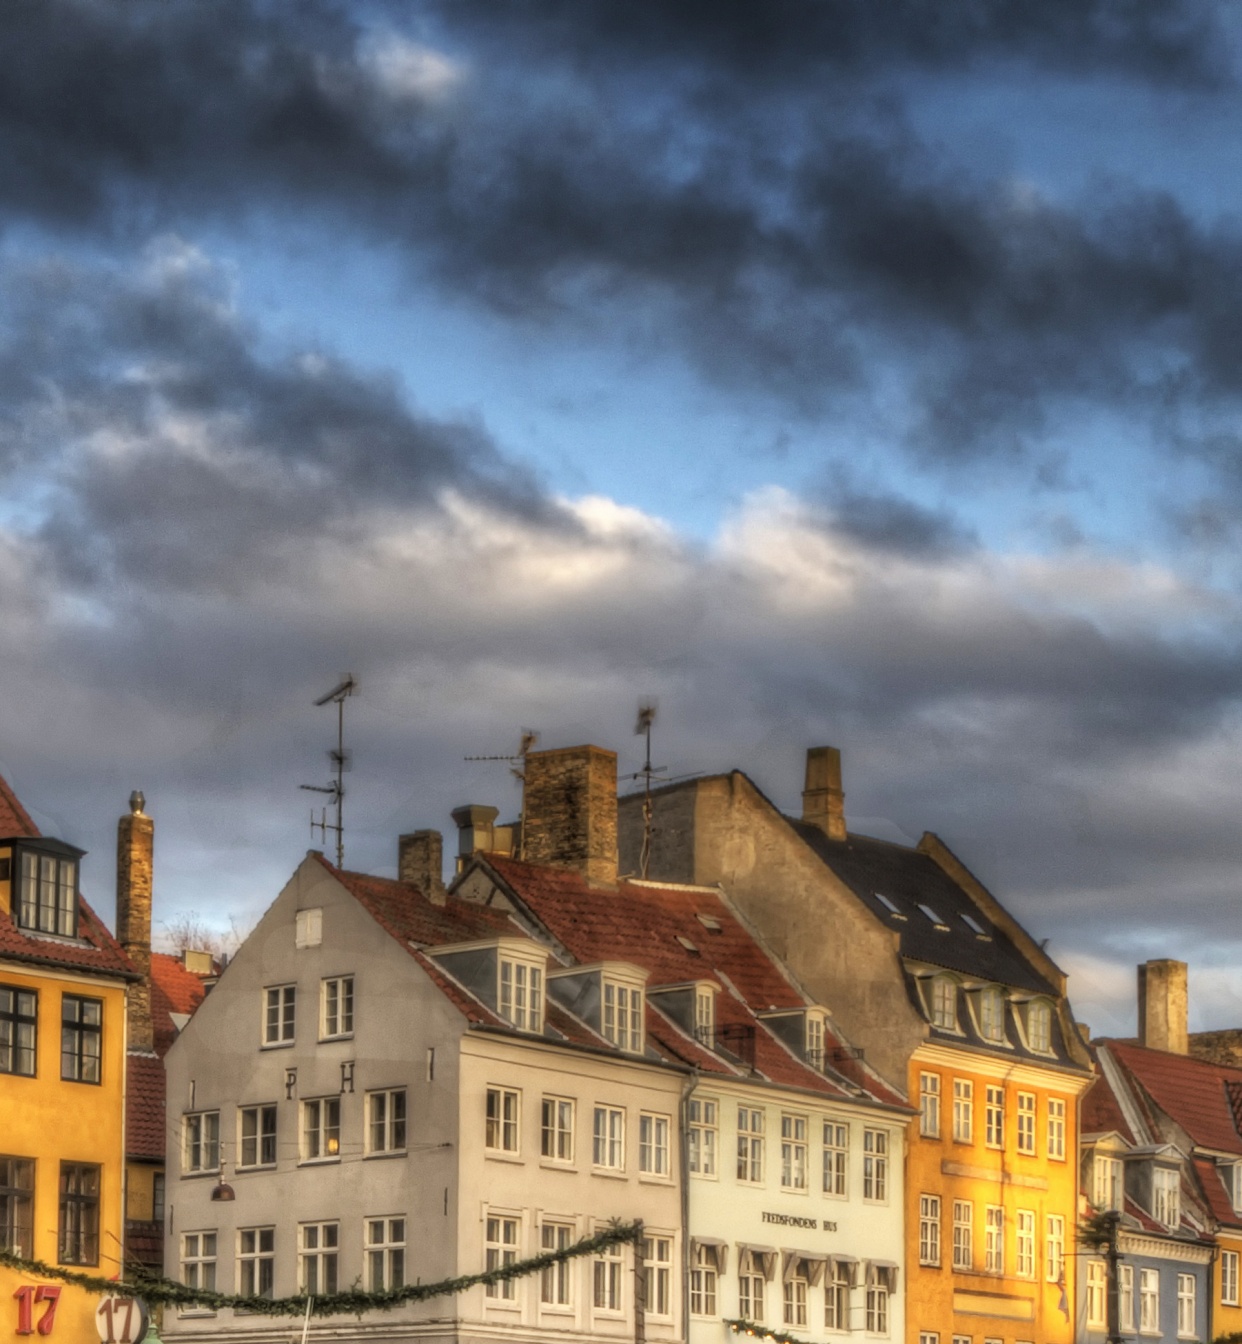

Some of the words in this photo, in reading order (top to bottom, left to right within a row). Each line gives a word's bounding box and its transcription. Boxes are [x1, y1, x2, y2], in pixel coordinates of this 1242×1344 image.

[340, 1063, 355, 1093] H
[762, 1211, 817, 1229] FREDSFONDENS
[823, 1220, 837, 1232] HUS
[13, 1285, 62, 1335] 17
[98, 1298, 134, 1344] 17
